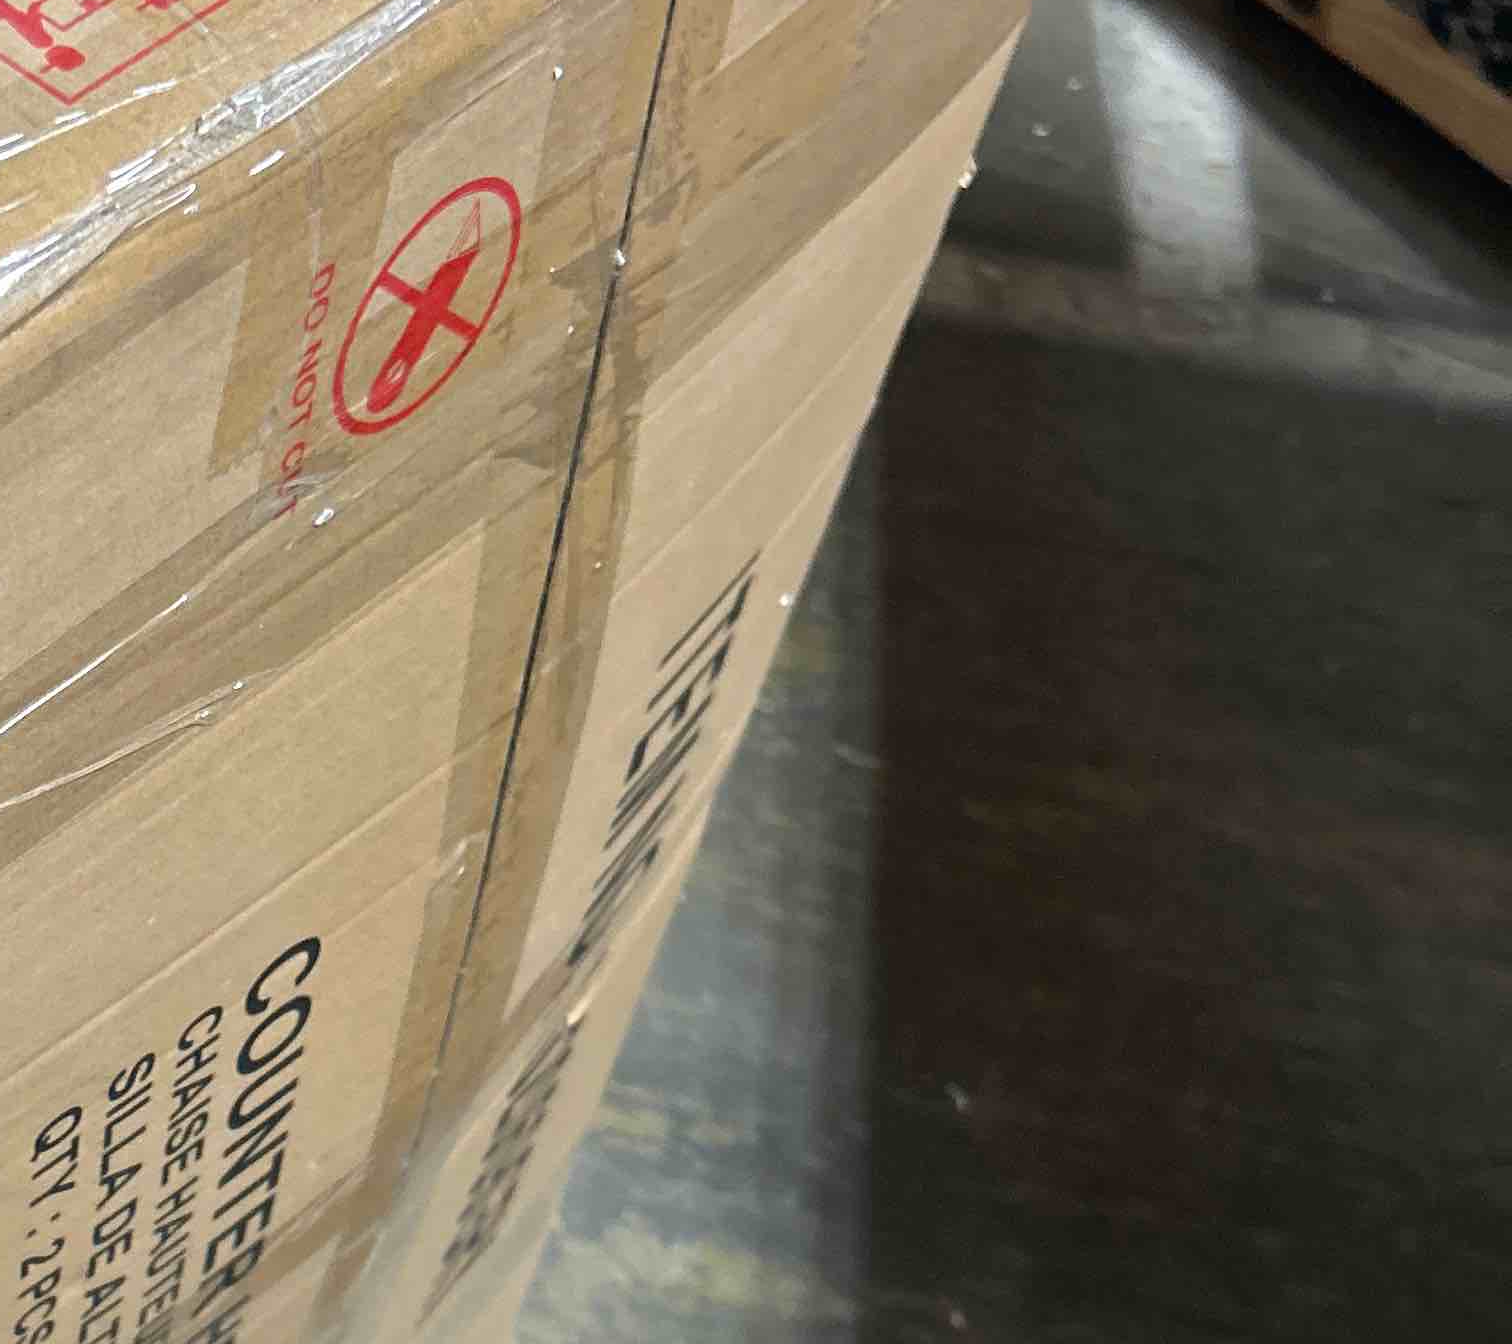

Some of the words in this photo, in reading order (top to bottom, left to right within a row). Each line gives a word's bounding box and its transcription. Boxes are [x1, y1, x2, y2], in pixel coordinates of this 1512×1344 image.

[304, 264, 335, 331] DO
[288, 339, 322, 429] NOT
[605, 554, 758, 848] ITEM
[96, 1053, 155, 1210] SILLA
[162, 1006, 223, 1186] CHAISE
[192, 936, 321, 1318] COUNTER
[30, 1106, 82, 1208] QTY
[21, 1237, 64, 1278] 2
[85, 1197, 137, 1278] DE
